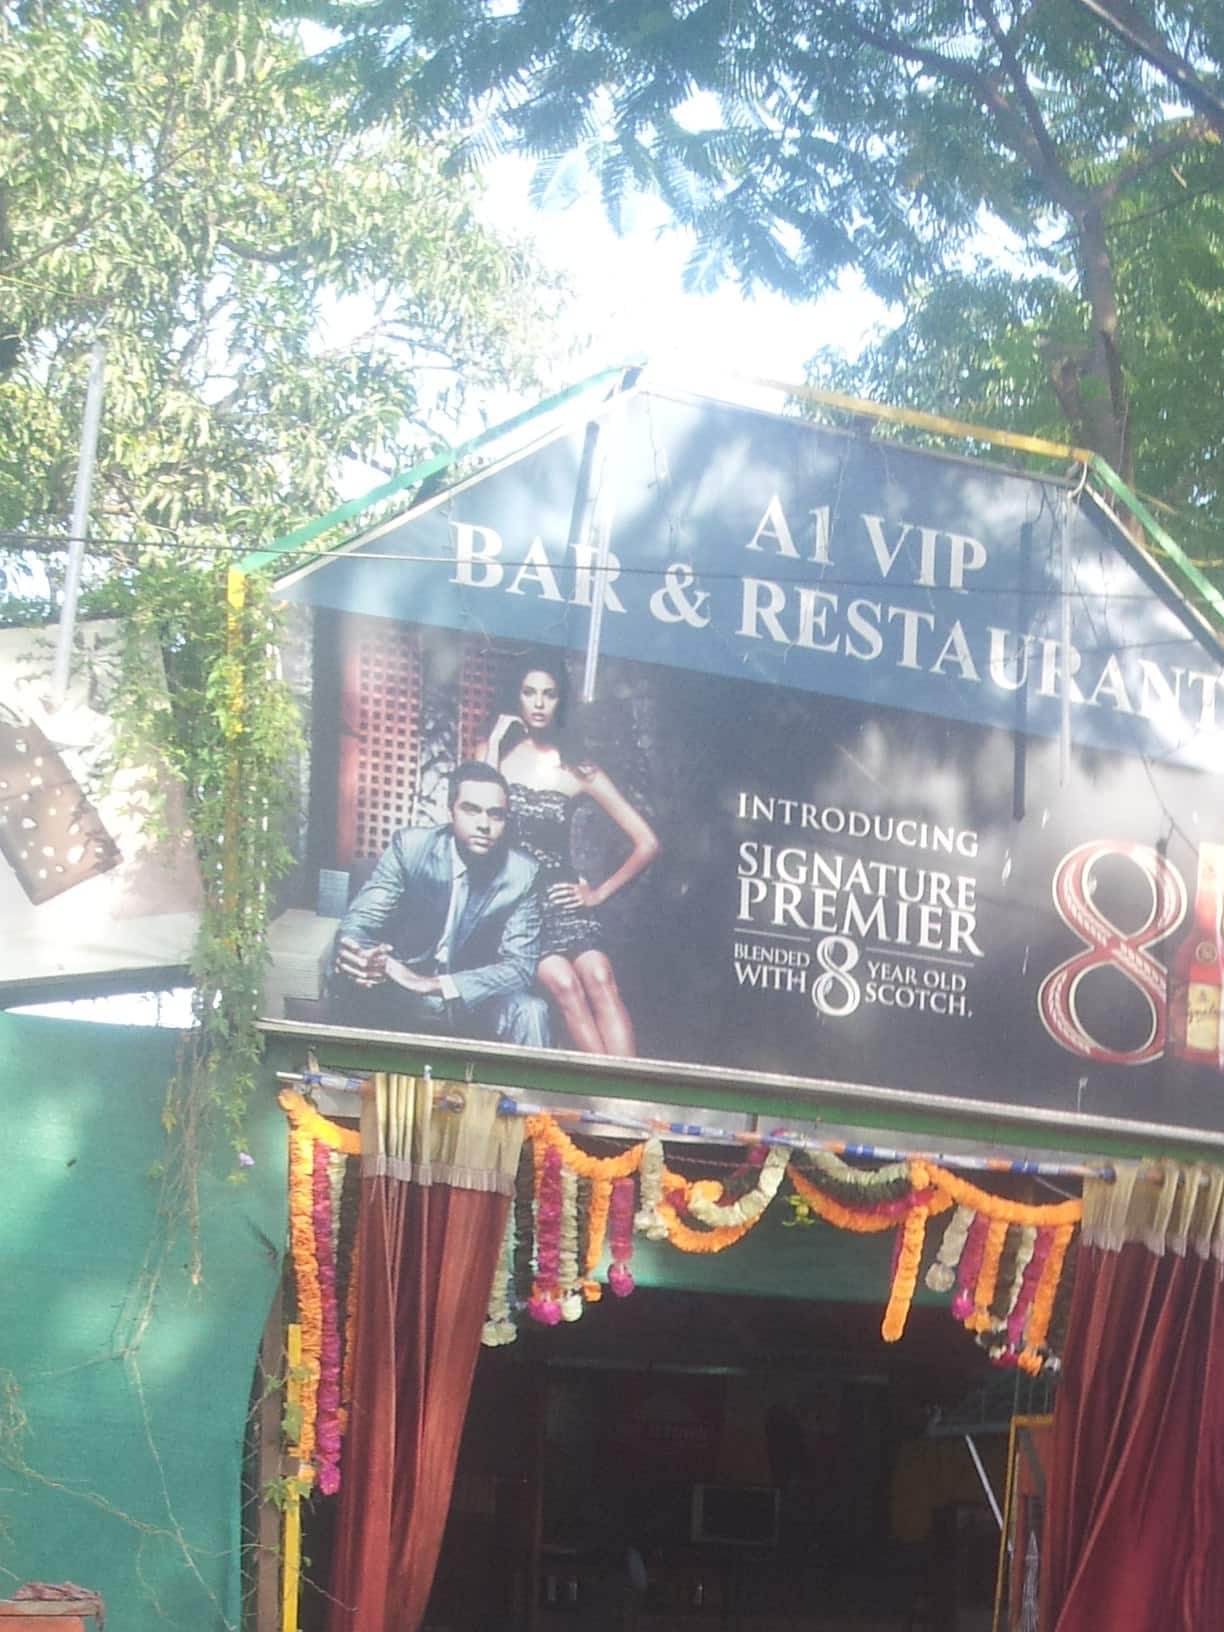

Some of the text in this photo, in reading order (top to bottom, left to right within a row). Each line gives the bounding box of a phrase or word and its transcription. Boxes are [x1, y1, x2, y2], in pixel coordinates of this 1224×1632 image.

[448, 520, 628, 614] BAR
[649, 562, 712, 629] &
[745, 494, 988, 594] A1 VIP
[736, 792, 979, 858] INTRODUCING
[737, 841, 977, 913] SIGNATURE
[736, 876, 985, 958] PREMIER
[734, 943, 811, 969] BLENDED
[734, 961, 807, 994] WITH
[811, 935, 862, 1017] 8
[866, 960, 967, 992] YEAR OLD
